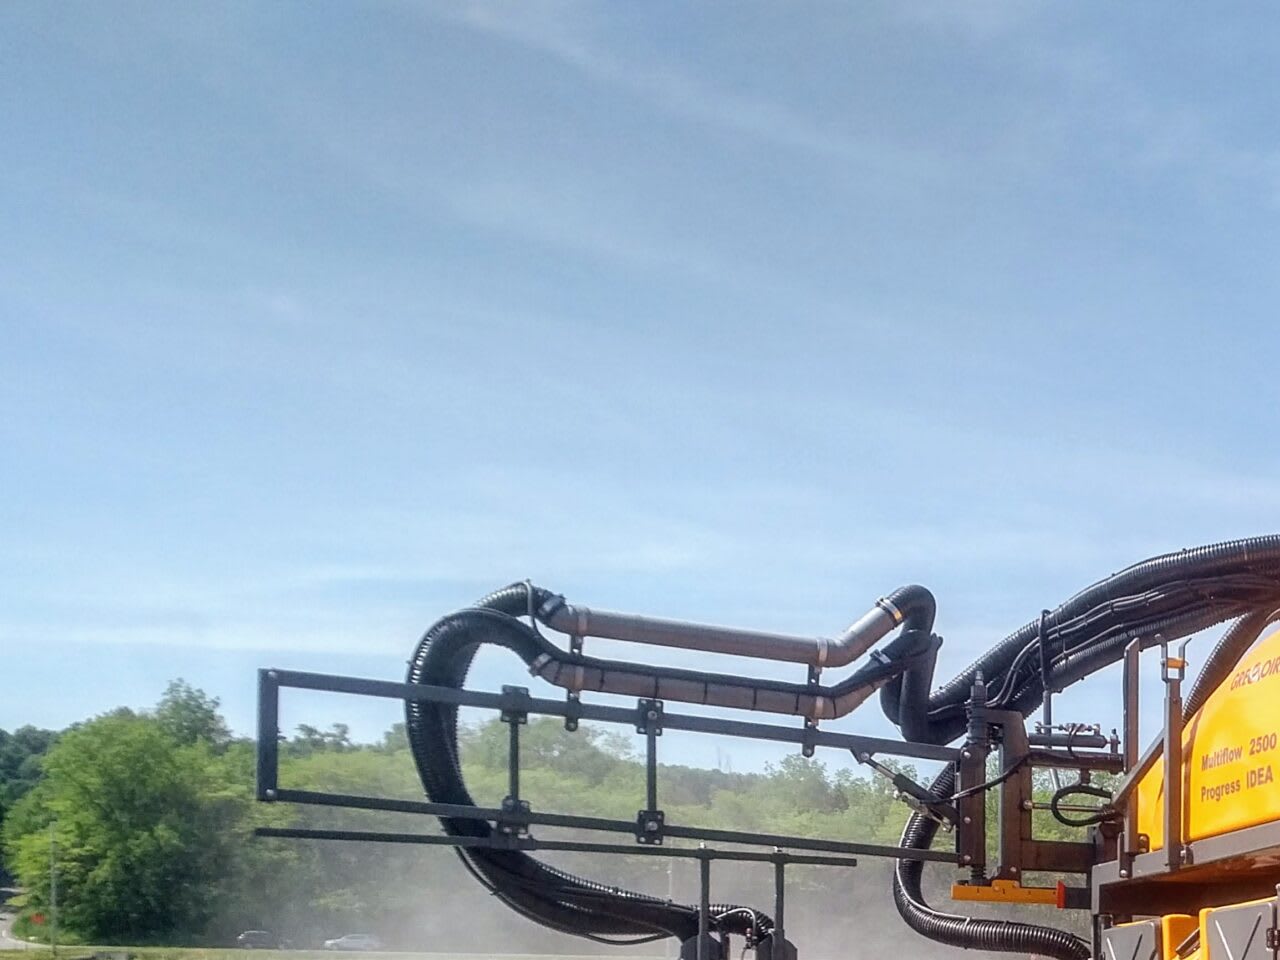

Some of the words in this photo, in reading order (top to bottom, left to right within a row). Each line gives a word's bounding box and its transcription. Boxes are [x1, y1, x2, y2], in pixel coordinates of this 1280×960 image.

[1201, 746, 1242, 772] Multiflow
[1249, 732, 1277, 756] 2500
[1200, 779, 1240, 802] Progress
[1246, 764, 1274, 790] IDEA
